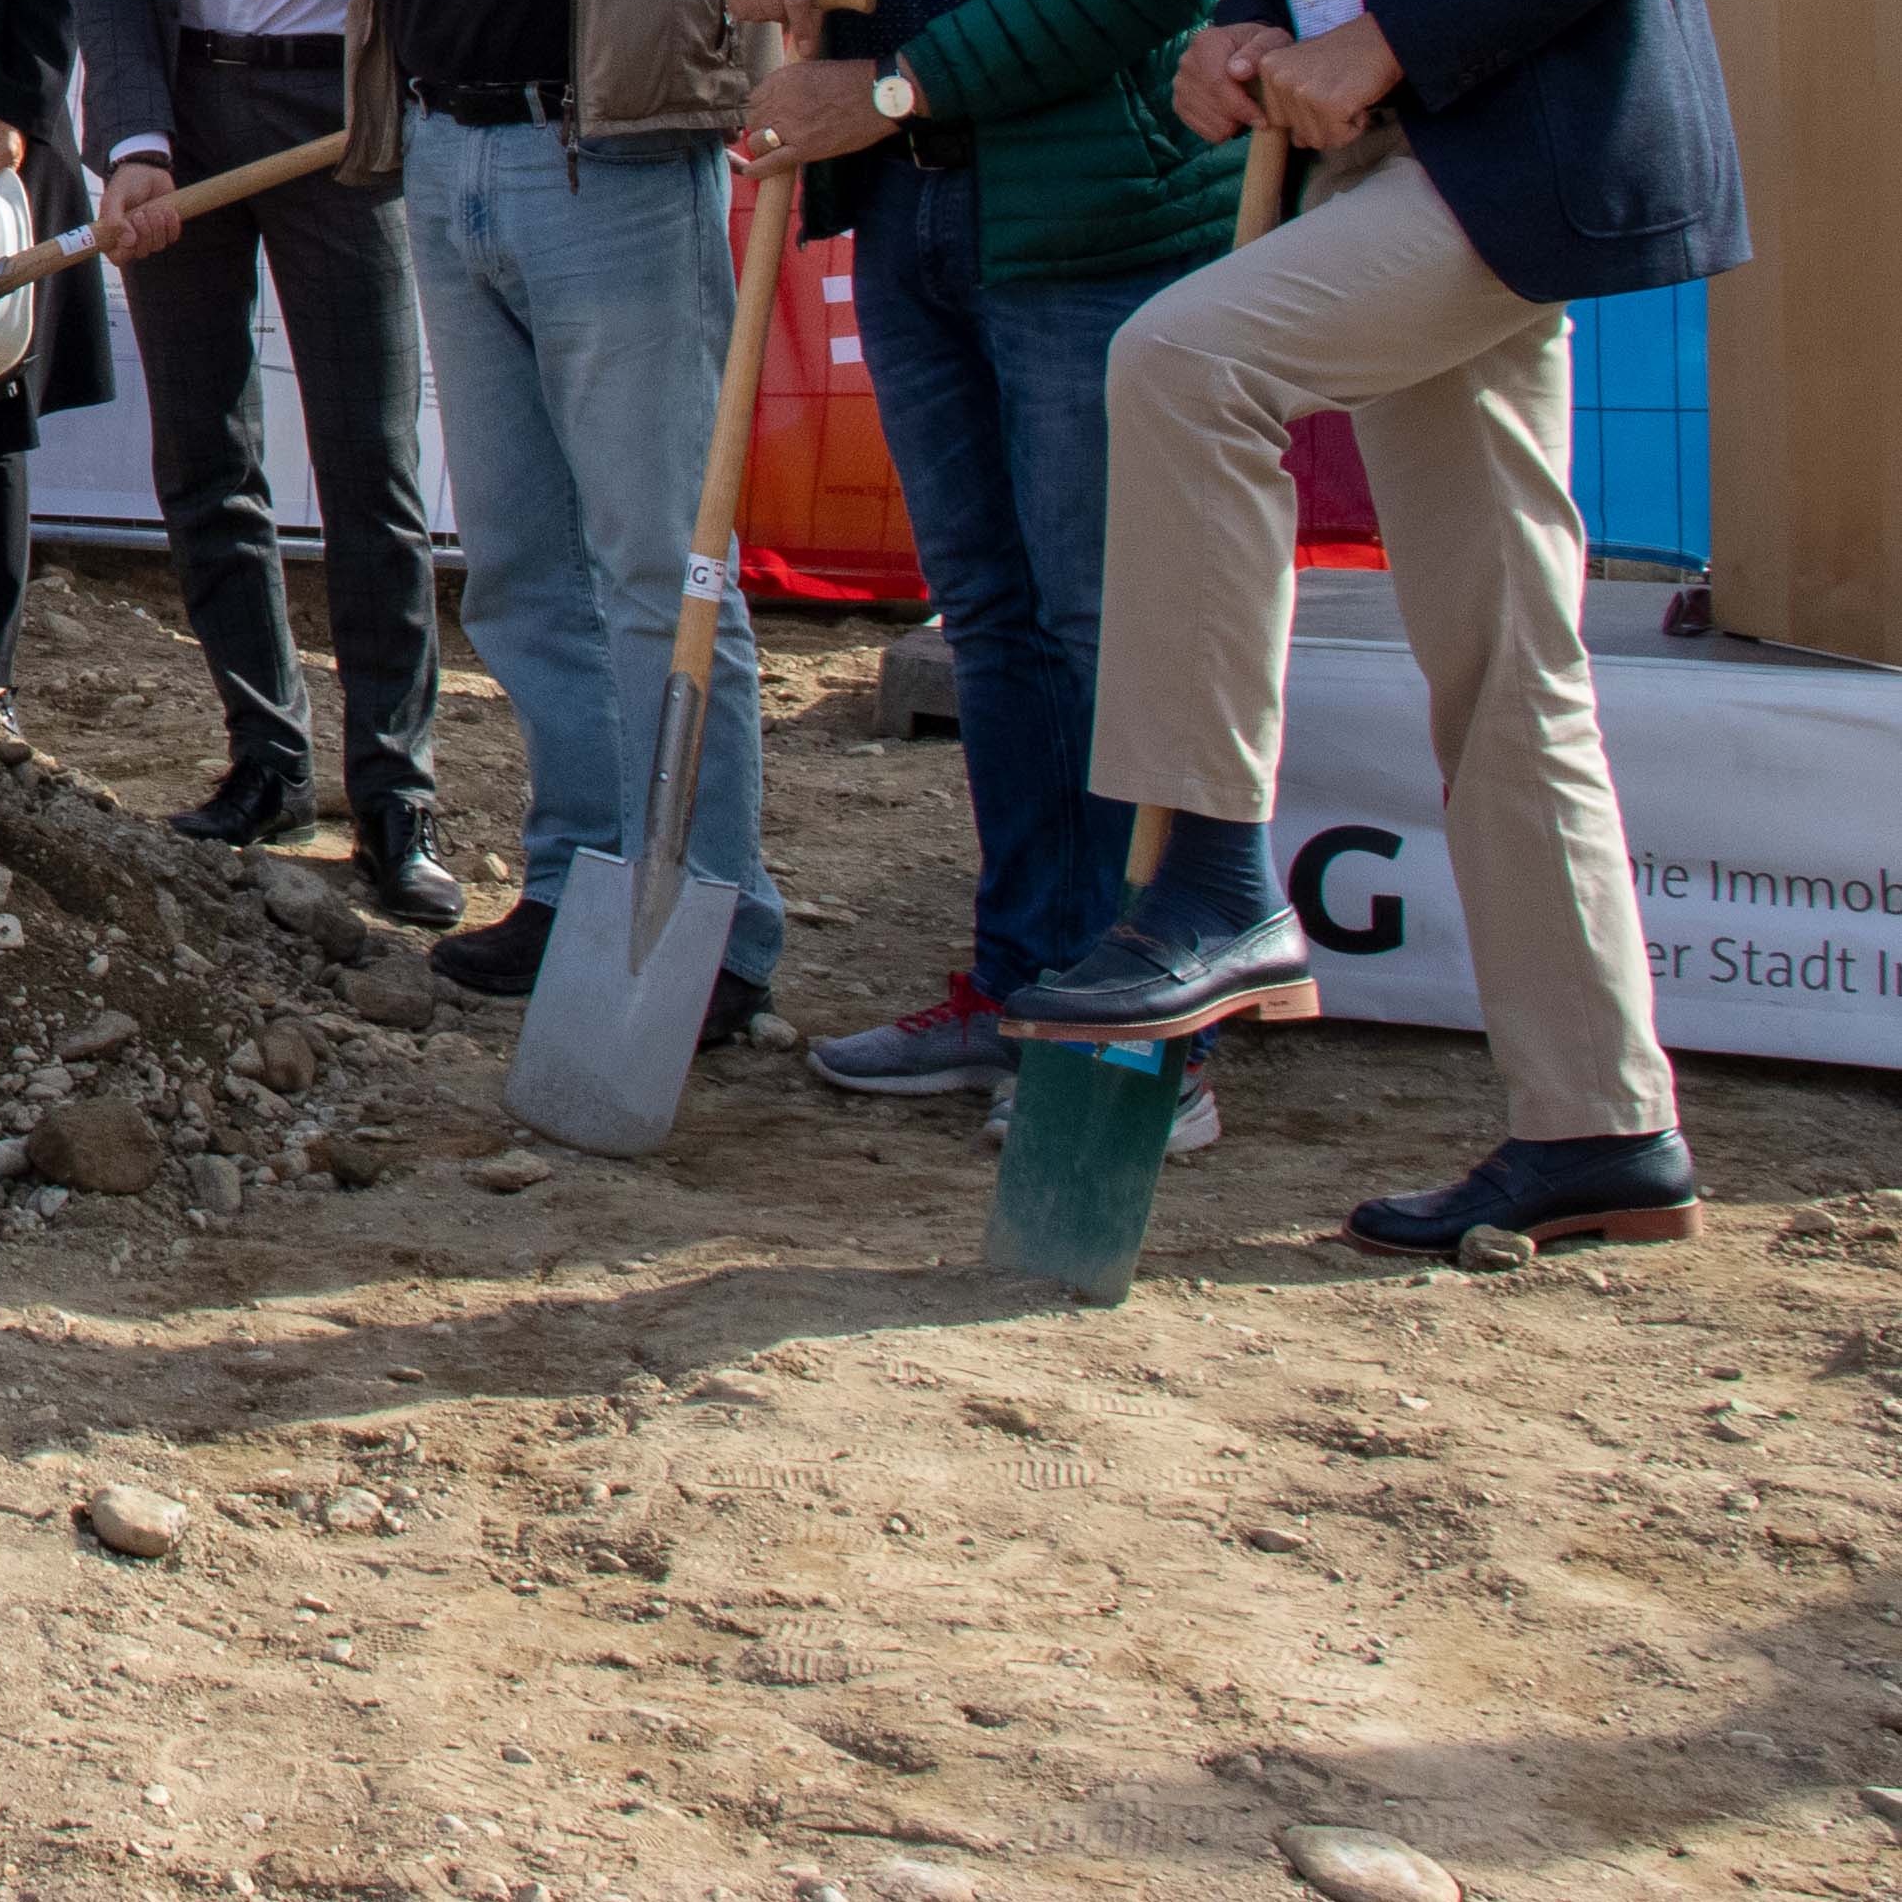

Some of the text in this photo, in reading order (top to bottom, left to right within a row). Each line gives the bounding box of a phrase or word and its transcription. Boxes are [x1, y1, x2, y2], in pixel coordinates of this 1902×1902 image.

[1631, 852, 1689, 899] ie
[1645, 941, 1693, 979] er
[1709, 936, 1859, 994] Stadt
